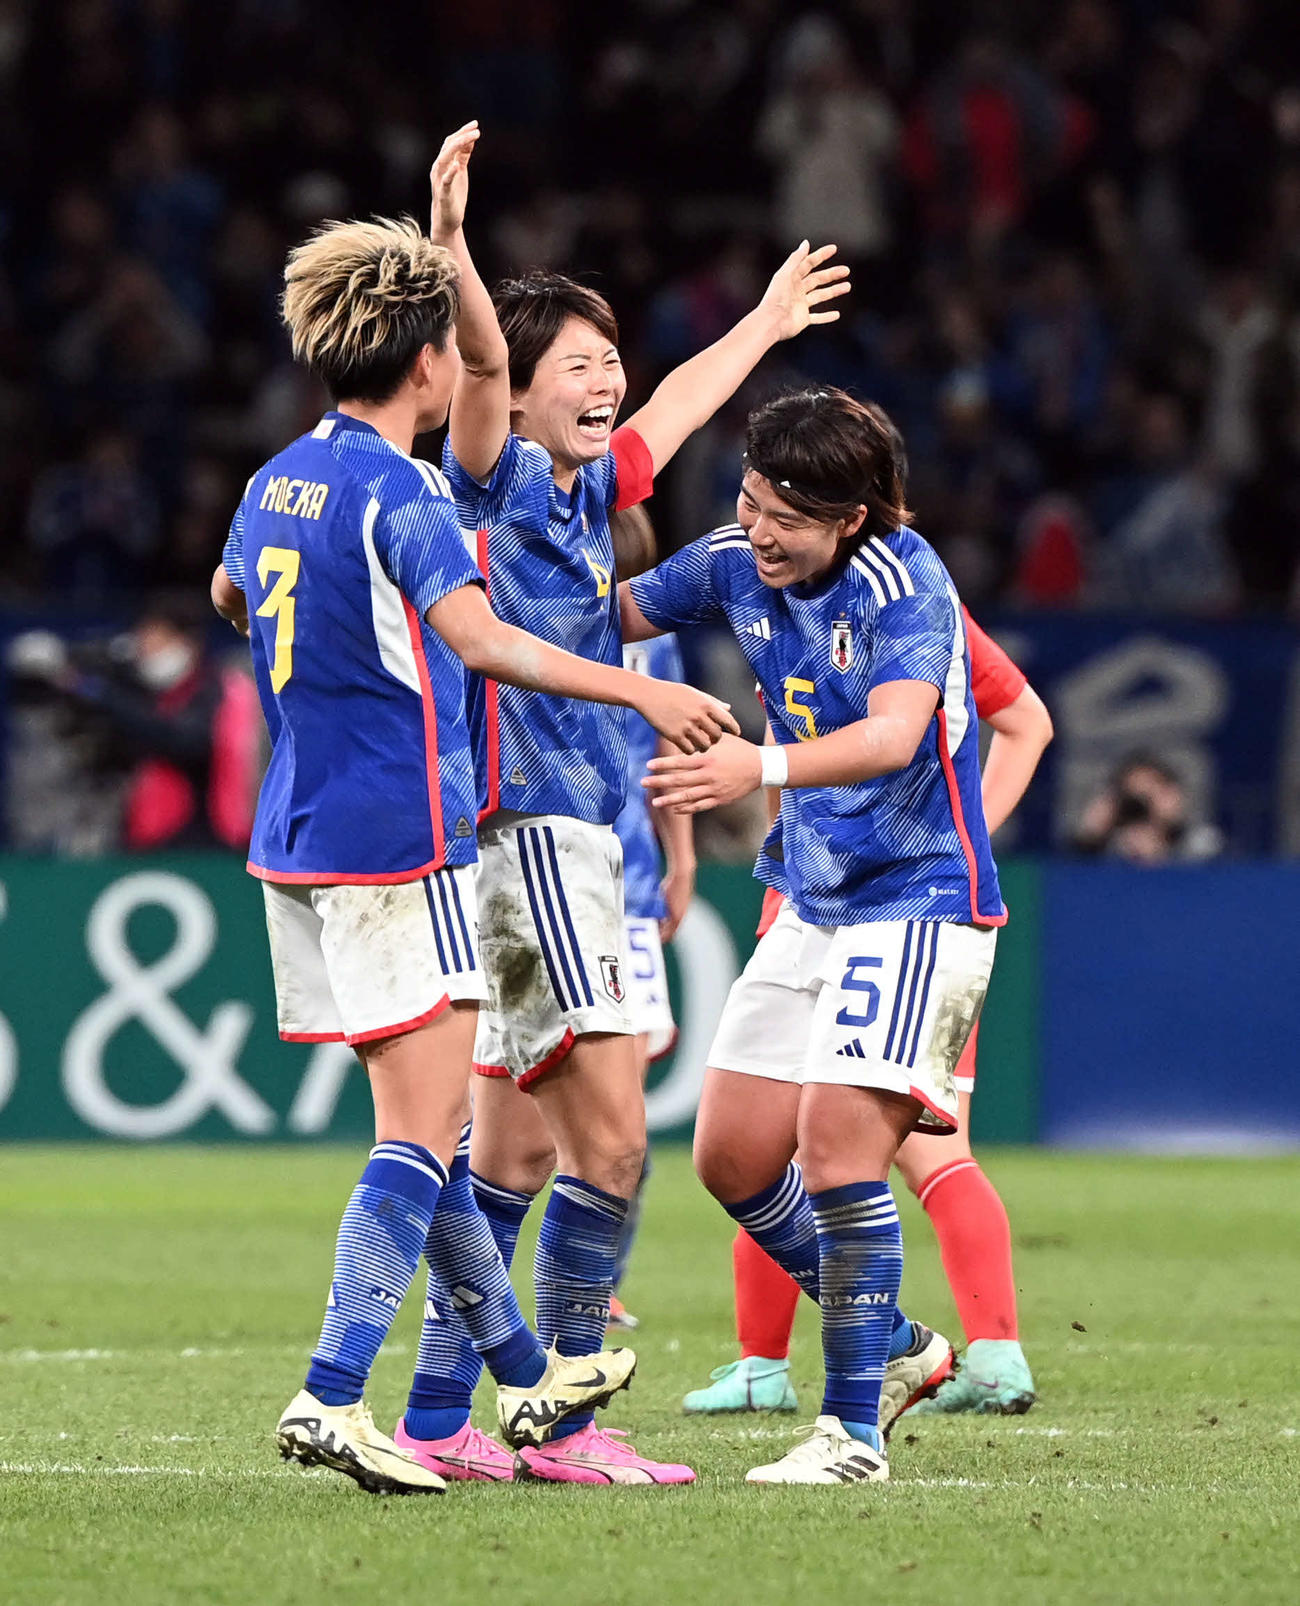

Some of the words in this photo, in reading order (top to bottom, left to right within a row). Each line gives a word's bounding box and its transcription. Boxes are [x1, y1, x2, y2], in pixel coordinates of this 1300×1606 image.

[259, 475, 329, 520] MOEKA
[256, 546, 300, 694] 3
[784, 677, 816, 742] 5
[836, 956, 883, 1027] 5
